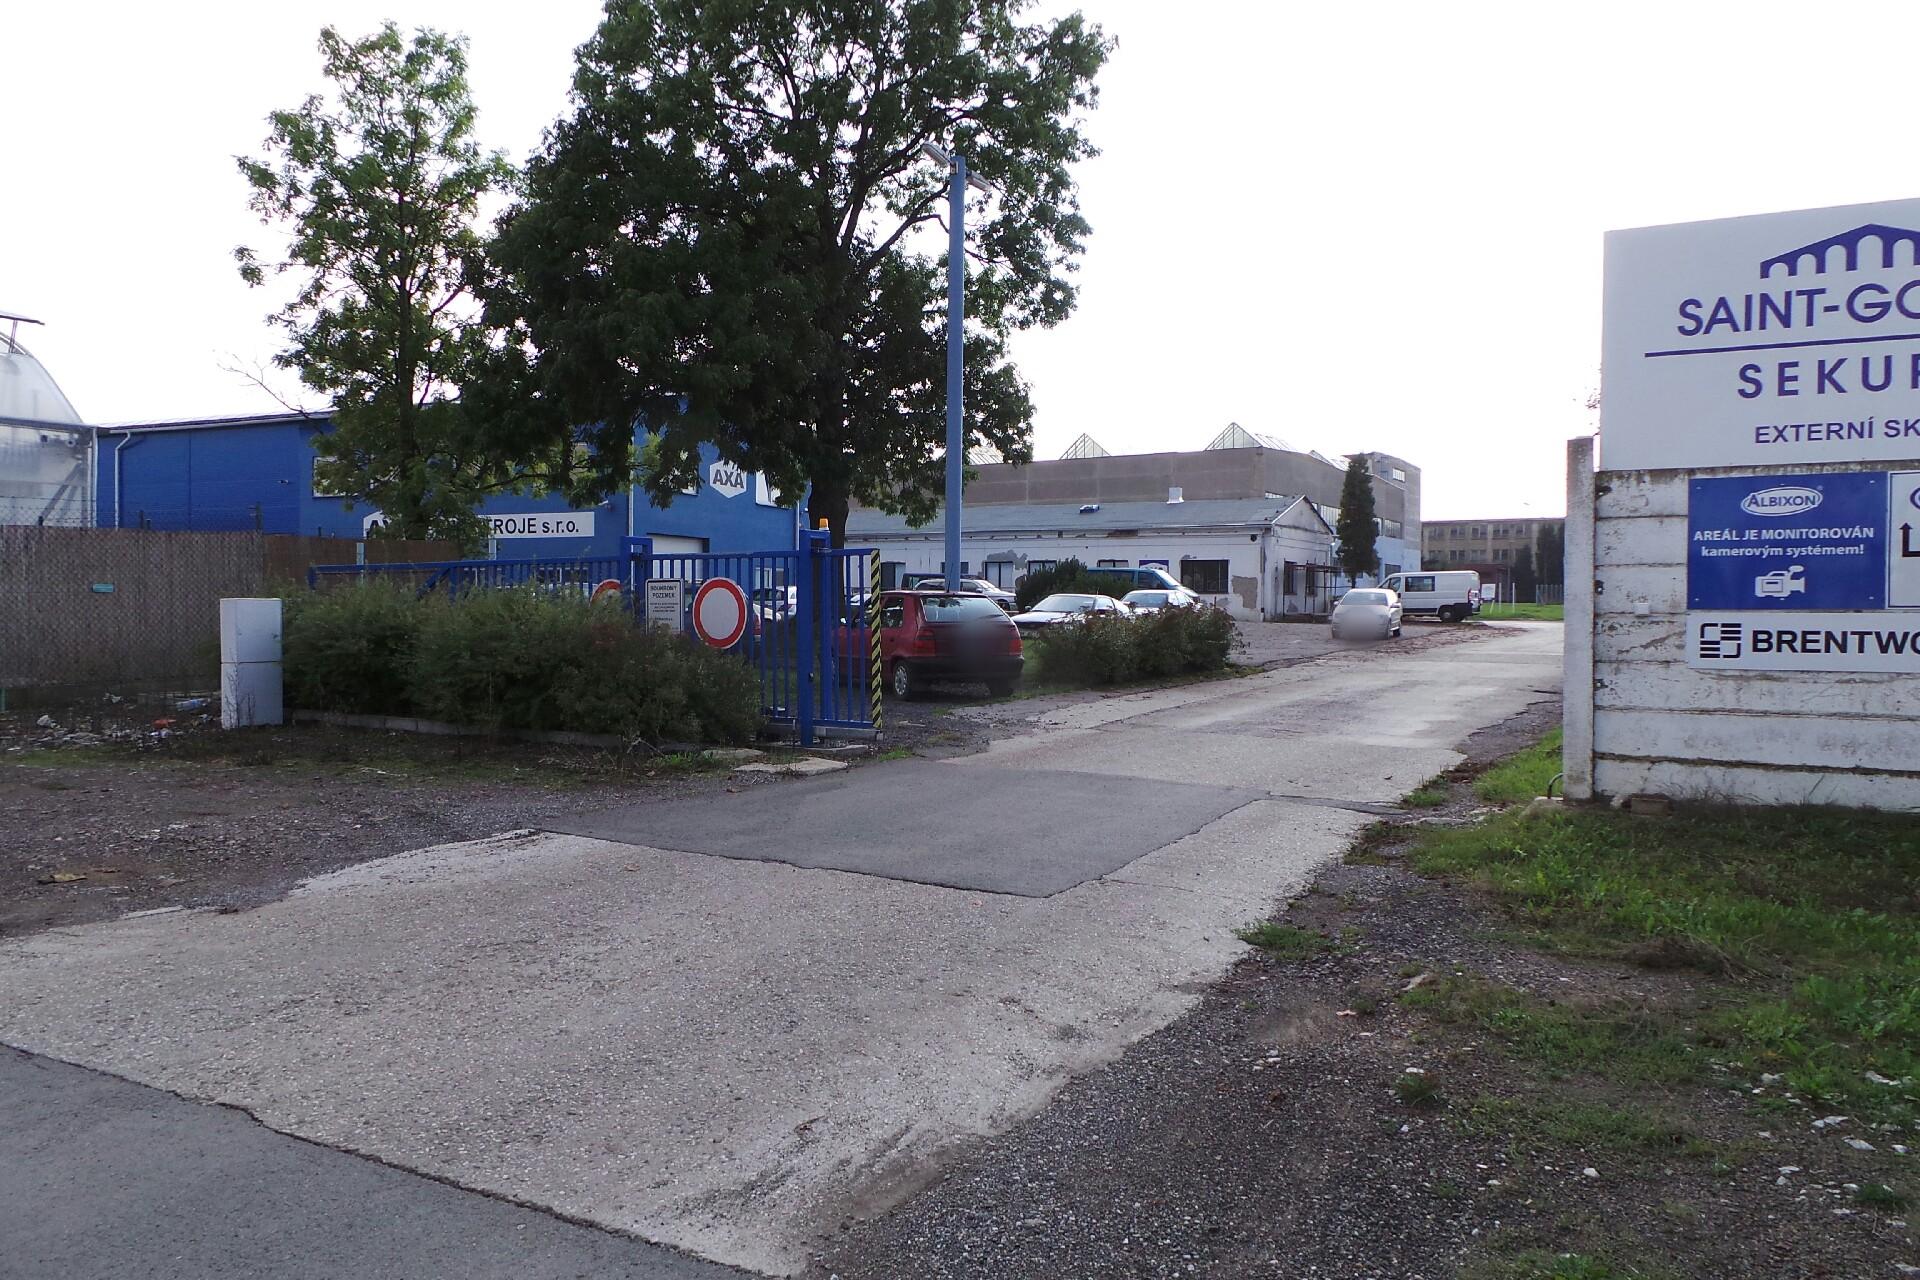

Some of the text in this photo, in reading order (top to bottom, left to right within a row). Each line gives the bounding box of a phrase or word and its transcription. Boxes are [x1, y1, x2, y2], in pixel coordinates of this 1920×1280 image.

[1754, 416, 1875, 444] EXTERNÍ
[712, 469, 745, 489] AXA
[1747, 494, 1817, 508] ALBIXON
[542, 520, 579, 534] s.r.o.
[1693, 526, 1875, 541] AREÁL JE MONITOROVÁN
[1701, 544, 1864, 559] kamerovým systémem!
